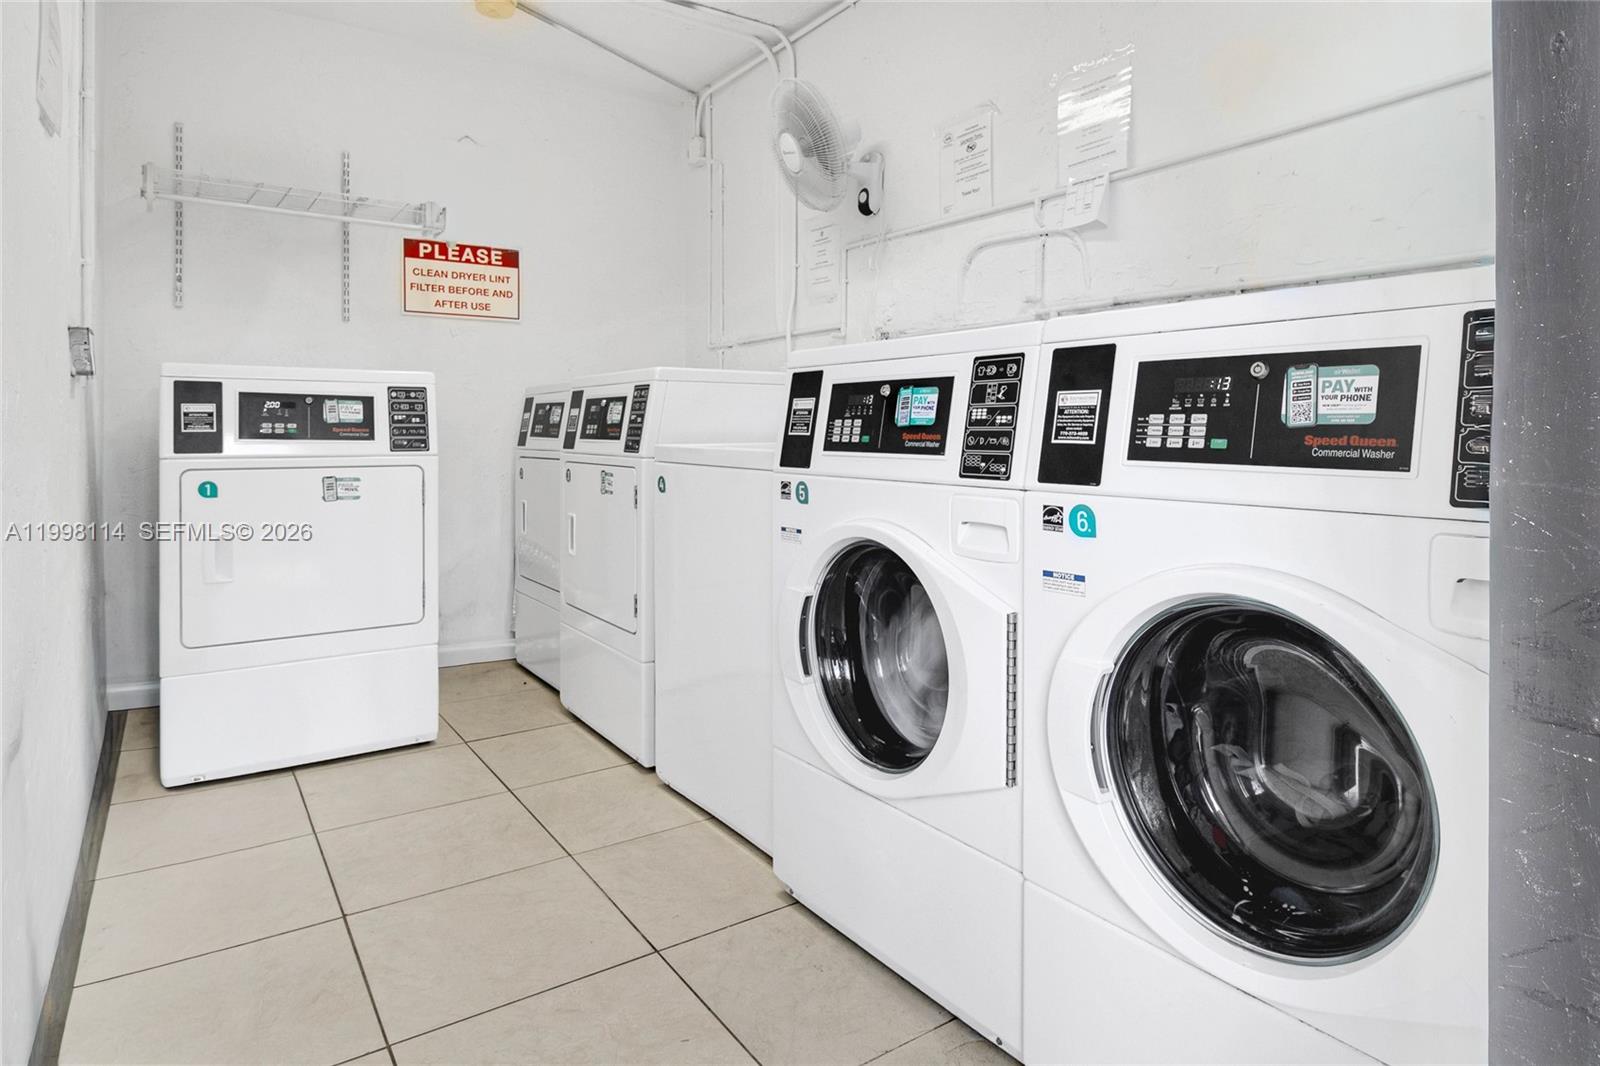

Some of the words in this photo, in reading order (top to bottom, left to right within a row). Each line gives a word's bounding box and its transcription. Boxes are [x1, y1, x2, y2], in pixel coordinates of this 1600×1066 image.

[419, 242, 503, 265] PLEASE
[412, 267, 448, 278] CLEAN
[451, 271, 486, 281] DRYER
[489, 275, 511, 284] LINT
[410, 282, 445, 293] FILTER
[448, 285, 489, 296] BEFORE
[492, 290, 513, 299] AND
[434, 299, 468, 309] AFTER
[471, 303, 491, 311] USE
[1321, 379, 1355, 394] PAY
[913, 395, 928, 404] PAY
[1339, 394, 1372, 402] PHONE
[902, 432, 921, 441] Speed
[1304, 435, 1348, 447] Speed
[1349, 435, 1397, 447] Queen
[1311, 447, 1360, 457] Commercial
[1361, 448, 1395, 459] Washer
[204, 485, 212, 496] 1
[798, 485, 806, 501] 5
